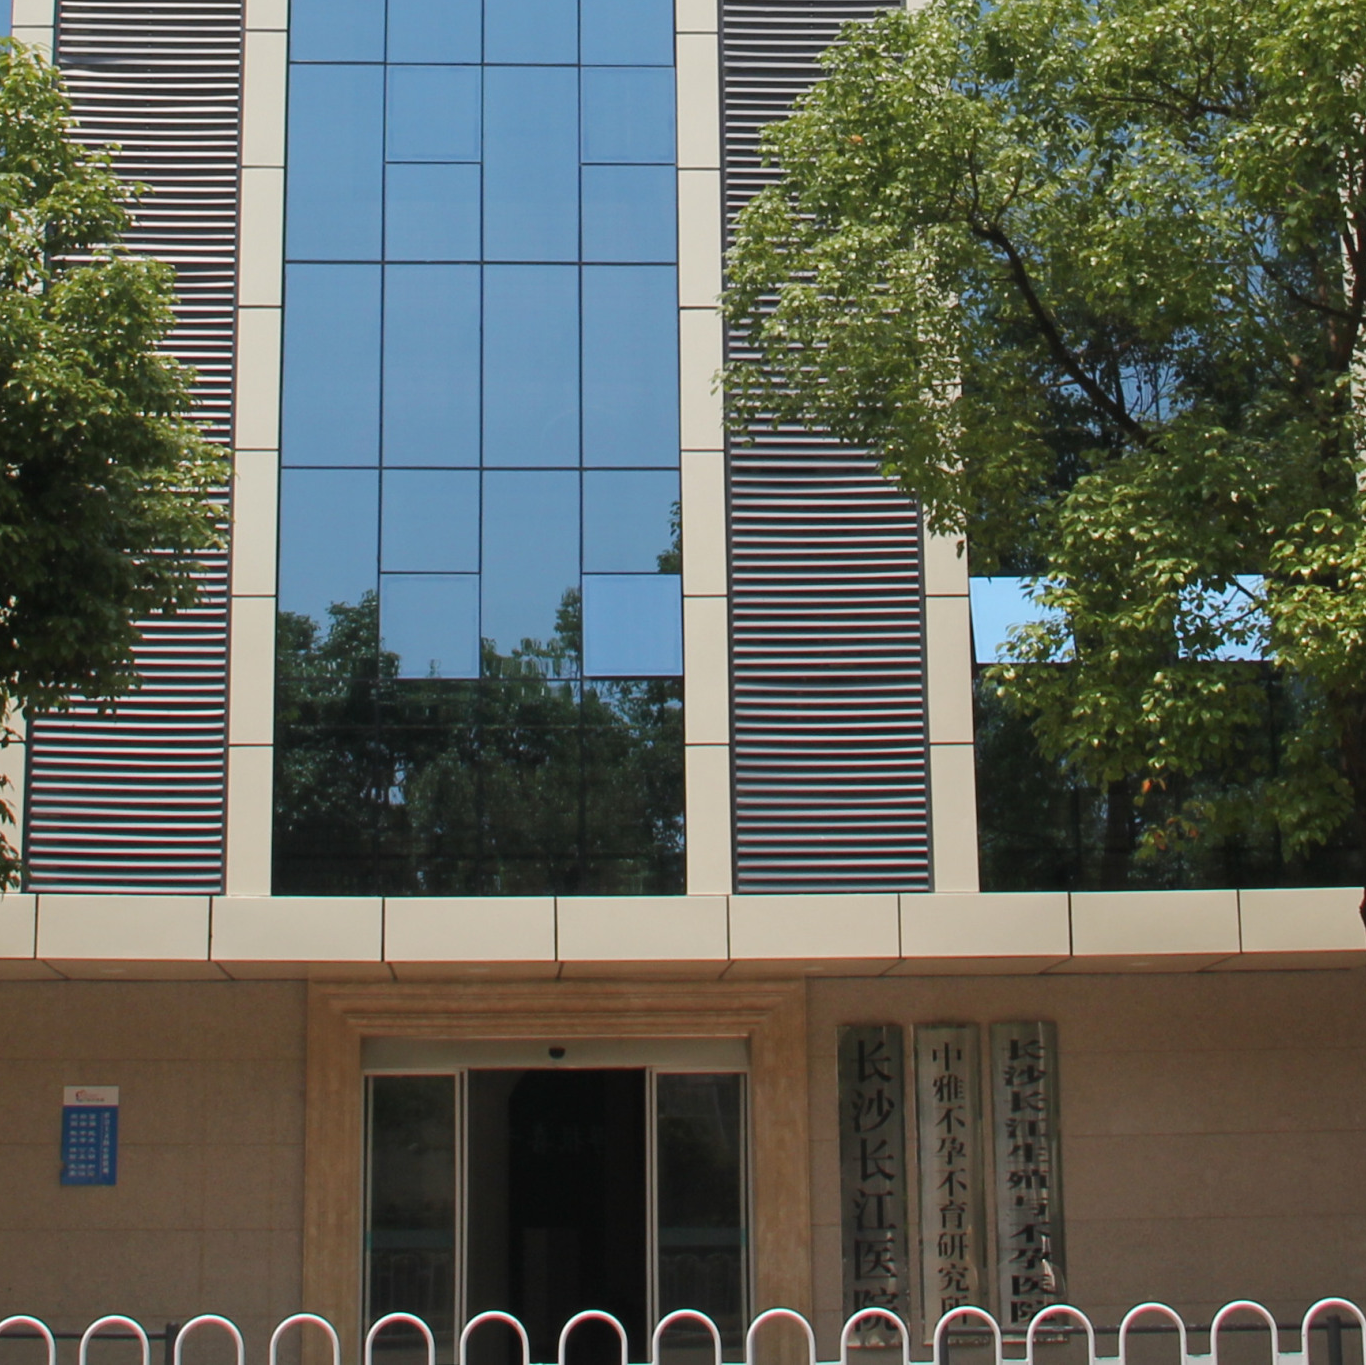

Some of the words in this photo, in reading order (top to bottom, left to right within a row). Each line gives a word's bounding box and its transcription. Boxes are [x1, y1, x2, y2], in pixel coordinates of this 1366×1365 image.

[851, 1038, 899, 1333] 长沙长江医院
[932, 1042, 970, 1326] 中雅不孕不育研究所
